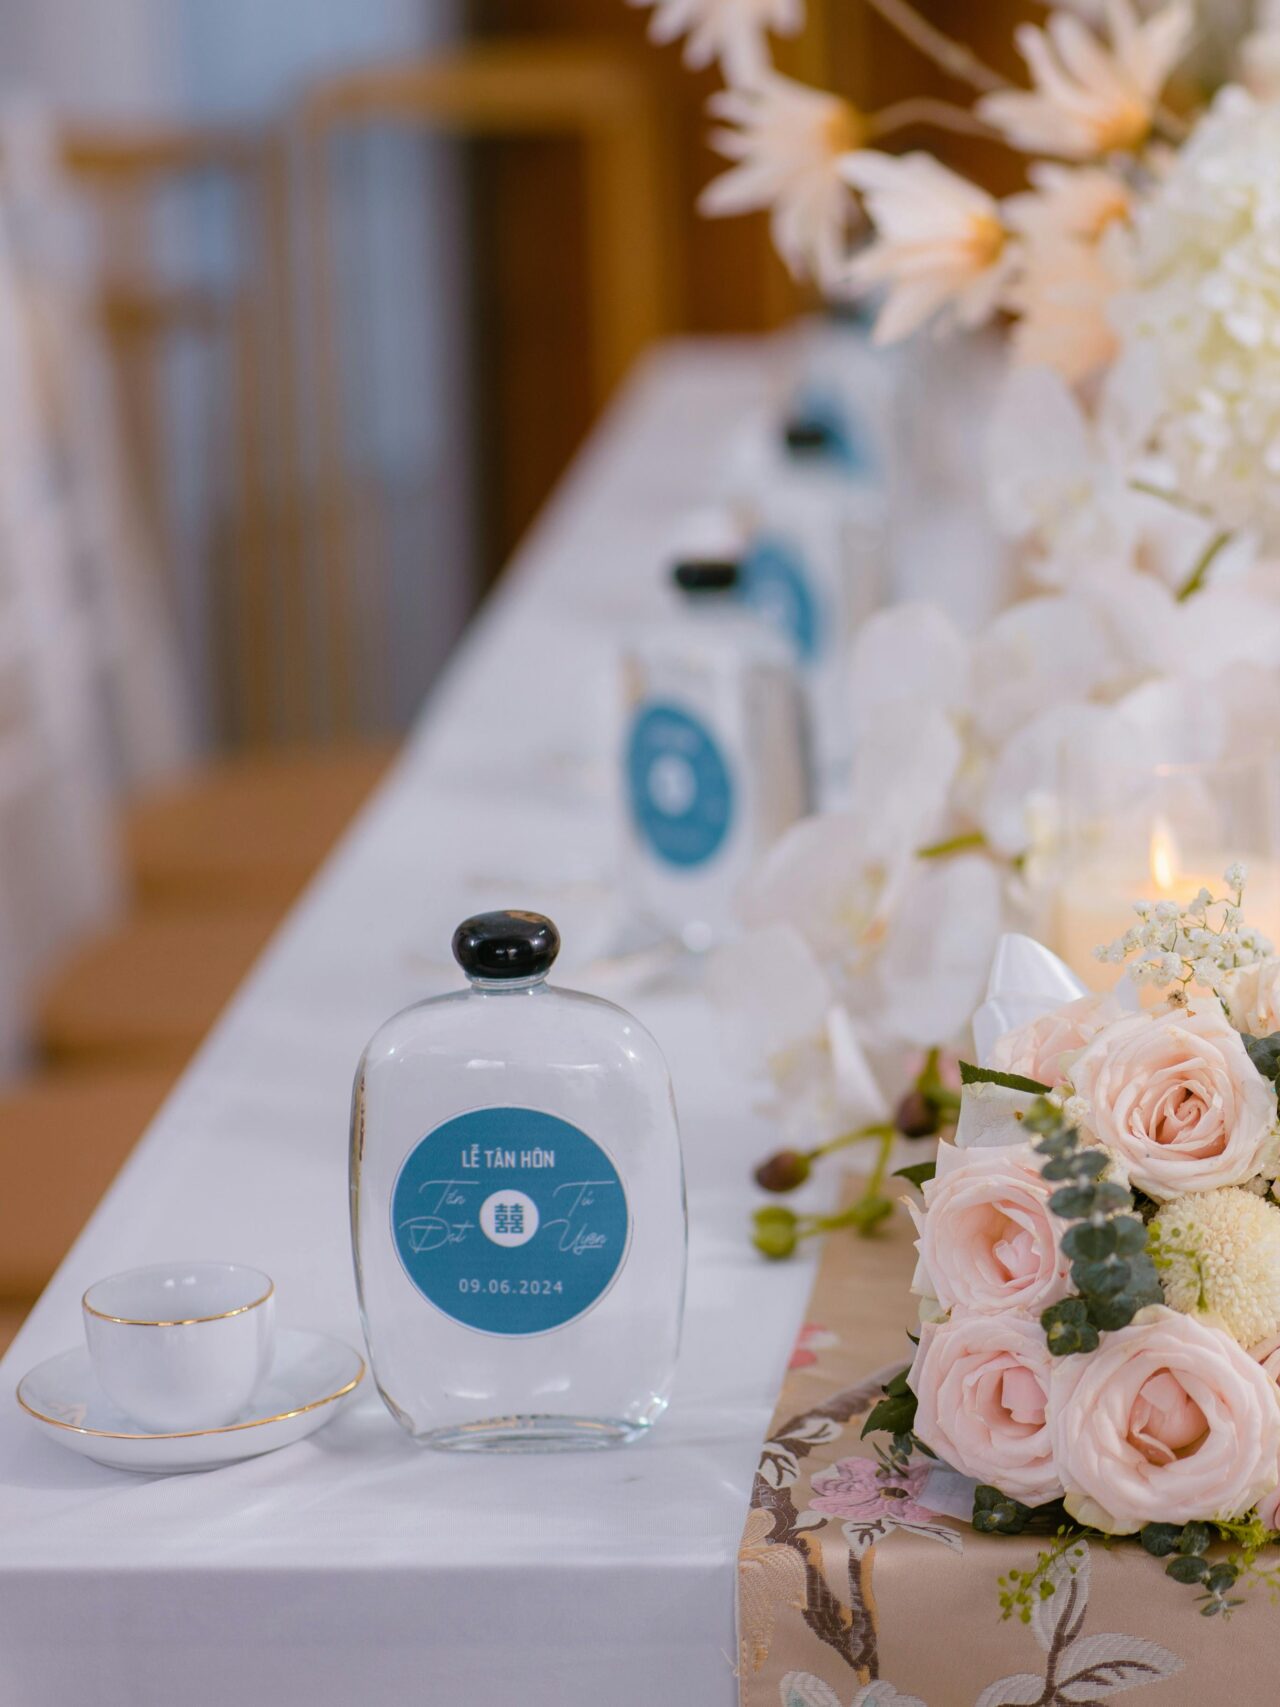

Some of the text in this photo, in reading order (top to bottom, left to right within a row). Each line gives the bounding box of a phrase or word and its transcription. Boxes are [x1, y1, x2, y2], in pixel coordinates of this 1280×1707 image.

[462, 1143, 555, 1168] LỄ TÂN HÔN
[458, 1278, 563, 1295] 09.06.2024
